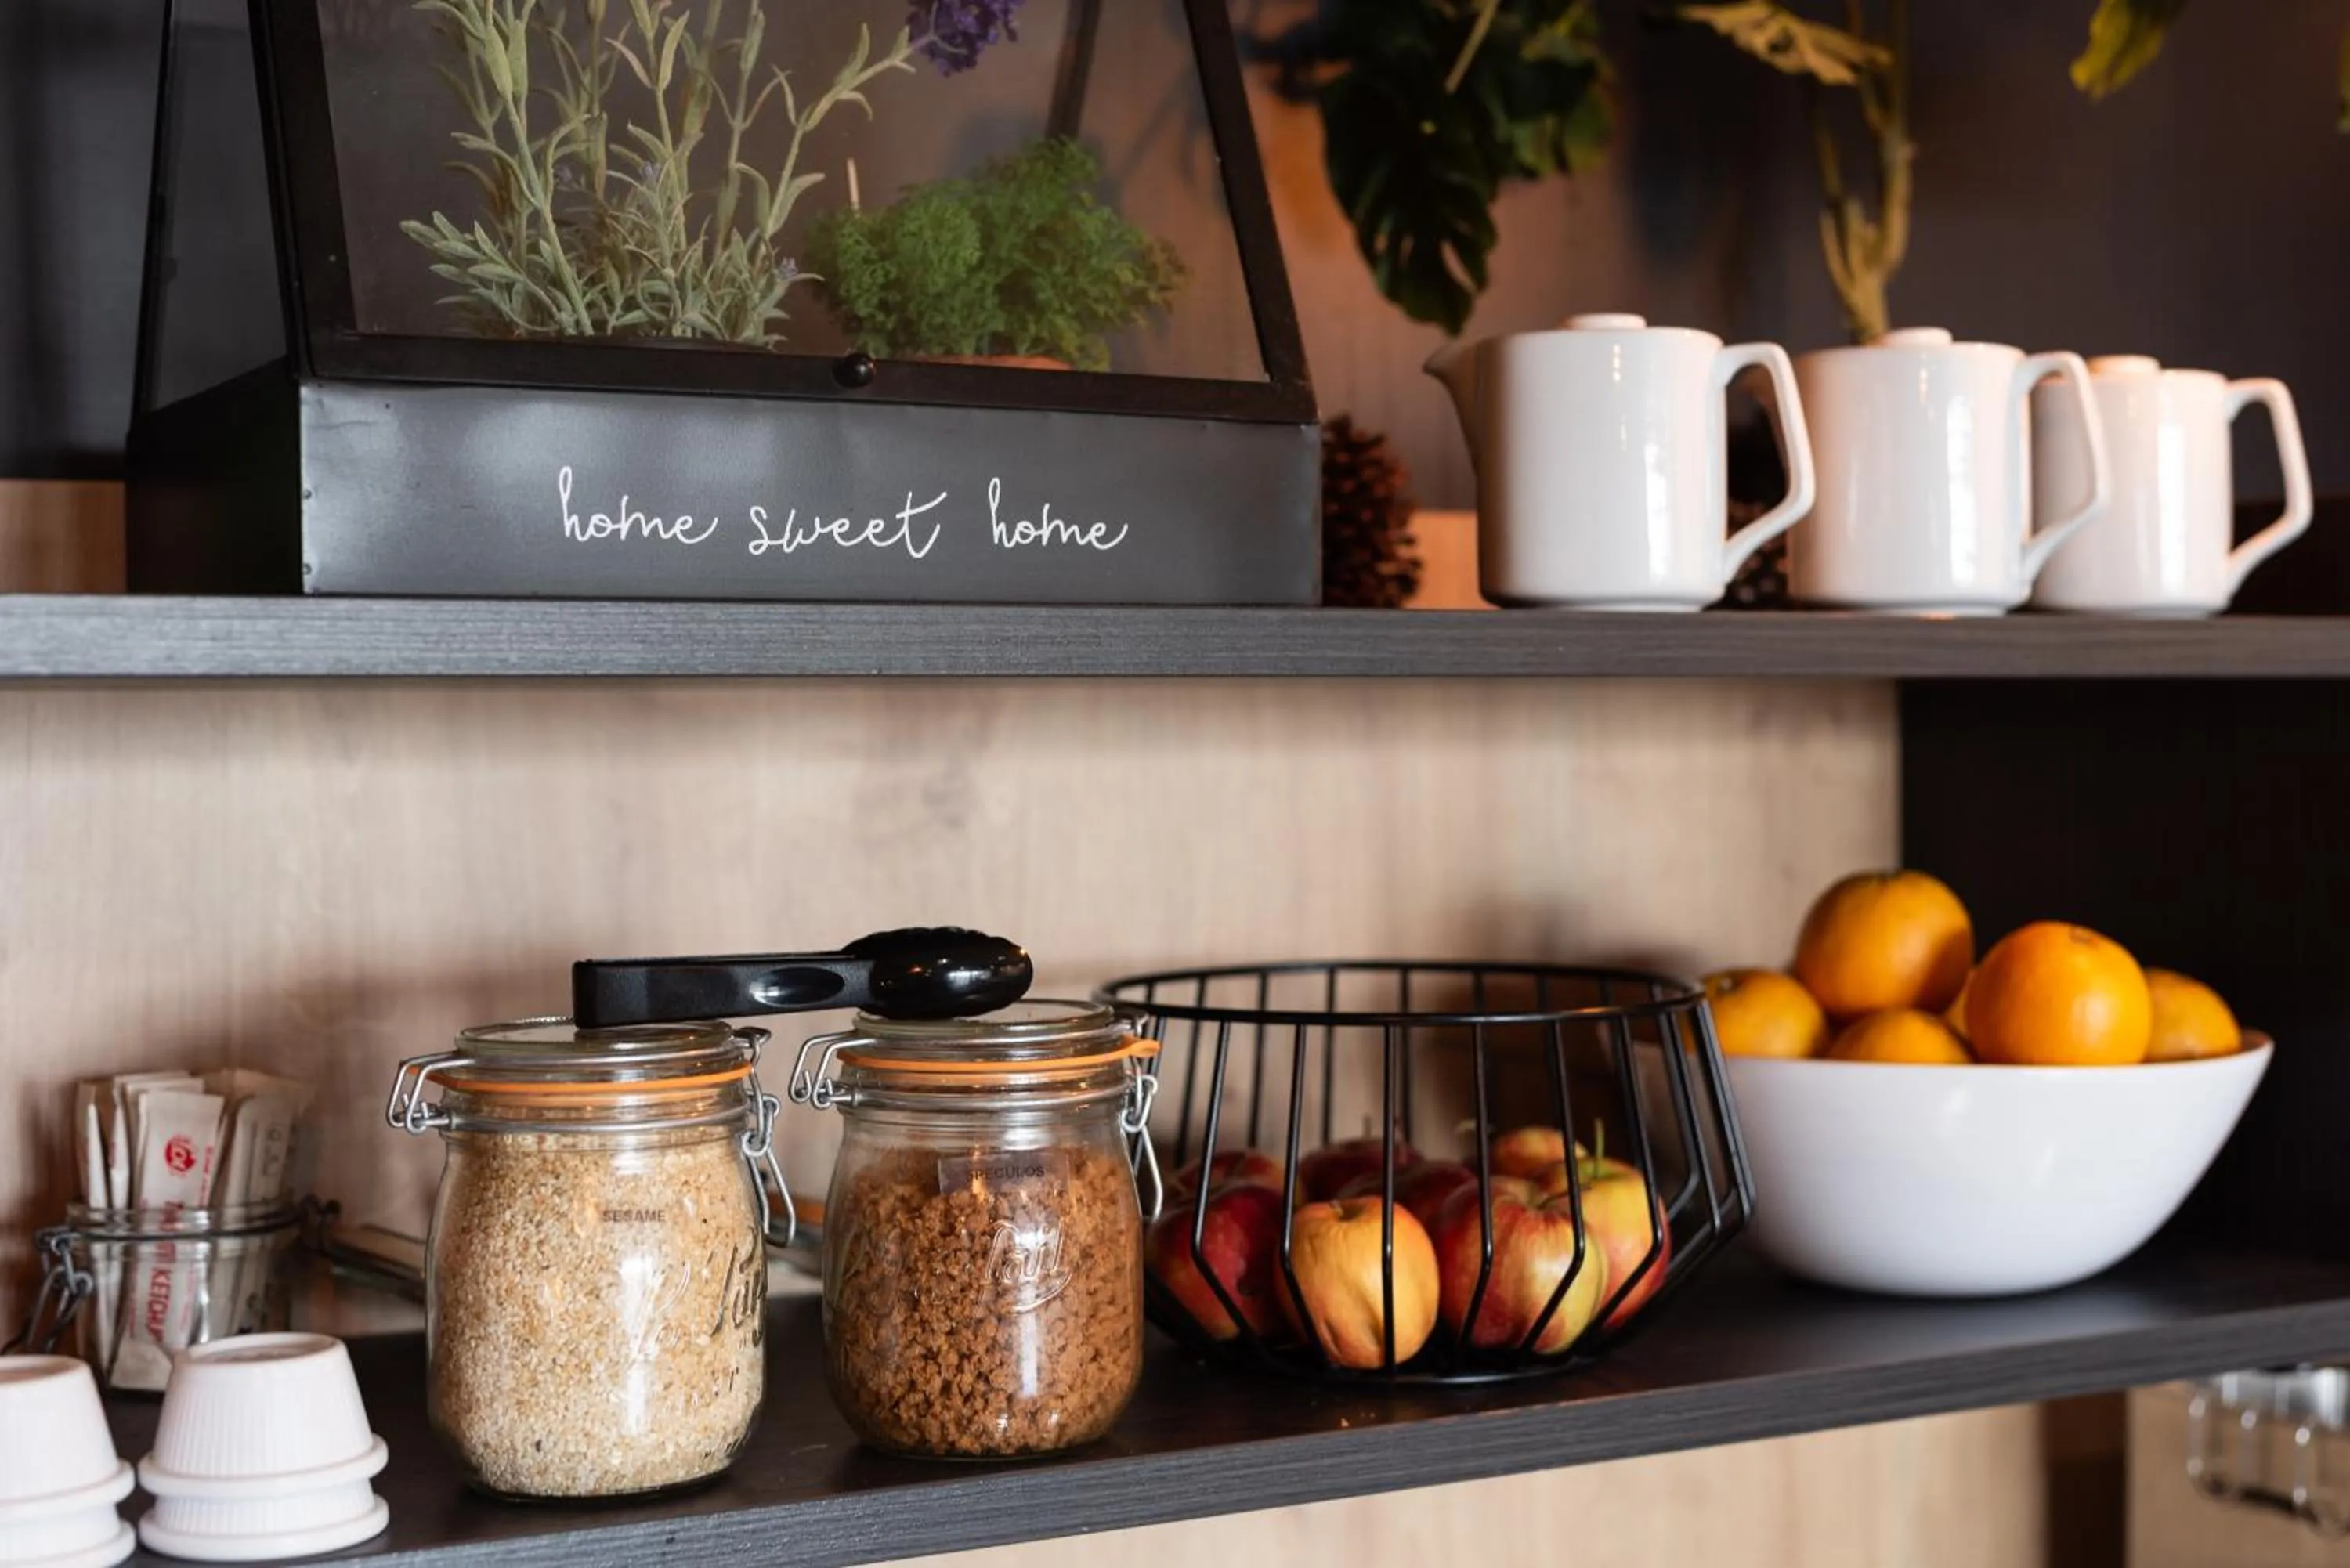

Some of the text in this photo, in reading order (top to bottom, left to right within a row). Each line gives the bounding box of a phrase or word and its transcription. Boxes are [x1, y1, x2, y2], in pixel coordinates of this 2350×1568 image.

[558, 464, 1128, 558] home sweet home
[602, 1209, 667, 1223] SESAME
